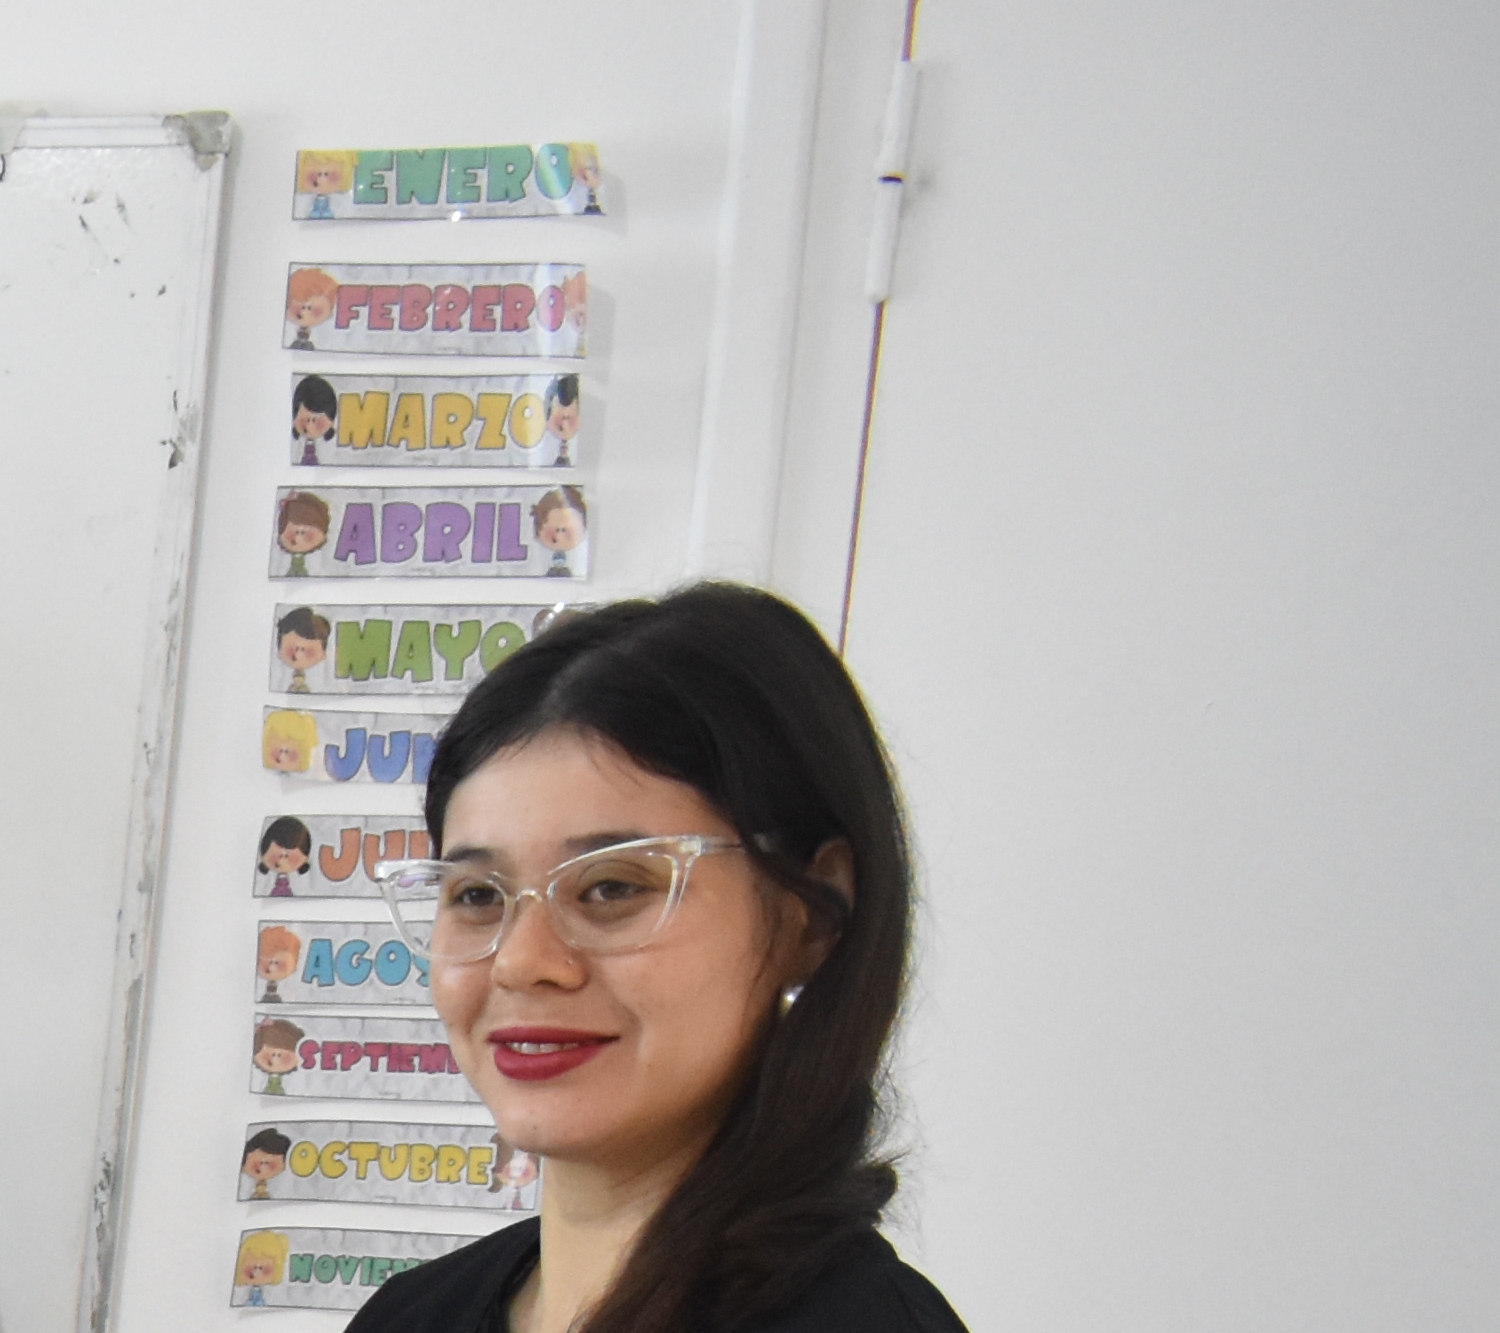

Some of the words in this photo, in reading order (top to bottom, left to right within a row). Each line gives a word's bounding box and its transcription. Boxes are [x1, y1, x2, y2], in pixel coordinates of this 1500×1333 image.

[352, 143, 574, 205] ENERO
[334, 282, 567, 333] FEBRERO
[336, 390, 547, 452] MARZO
[334, 502, 529, 566] ABRIL
[334, 618, 528, 684] MAYO
[289, 1139, 495, 1187] OCTUBRE
